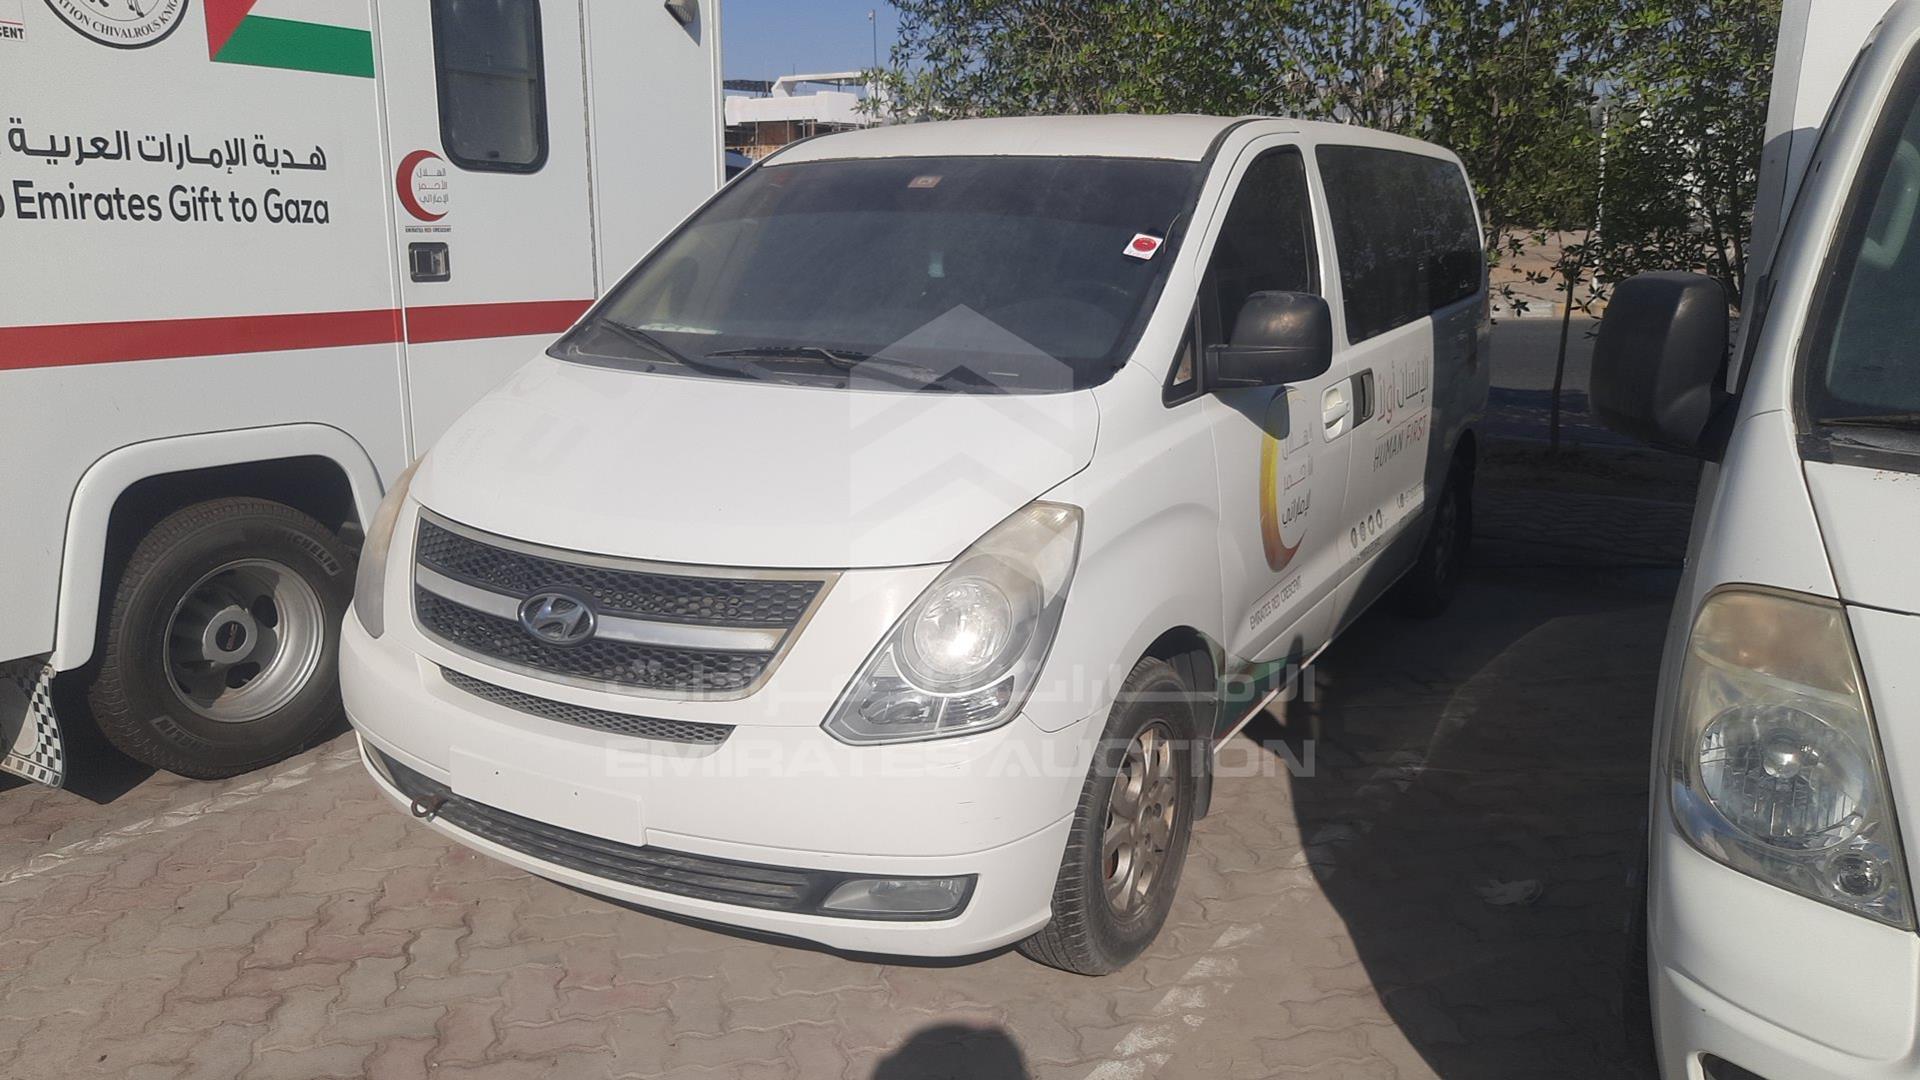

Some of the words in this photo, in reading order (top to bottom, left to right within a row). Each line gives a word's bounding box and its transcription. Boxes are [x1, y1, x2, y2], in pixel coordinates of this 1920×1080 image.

[93, 20, 161, 39] CHIVALROUS
[8, 117, 132, 165] العربية
[137, 133, 248, 174] الإمارات
[253, 134, 327, 175] هدية
[13, 180, 163, 222] Emirates
[169, 184, 224, 223] Gift
[230, 191, 258, 223] to
[264, 188, 331, 224] Gaza
[1373, 428, 1404, 472] HUMAN
[1405, 413, 1428, 449] FIRST
